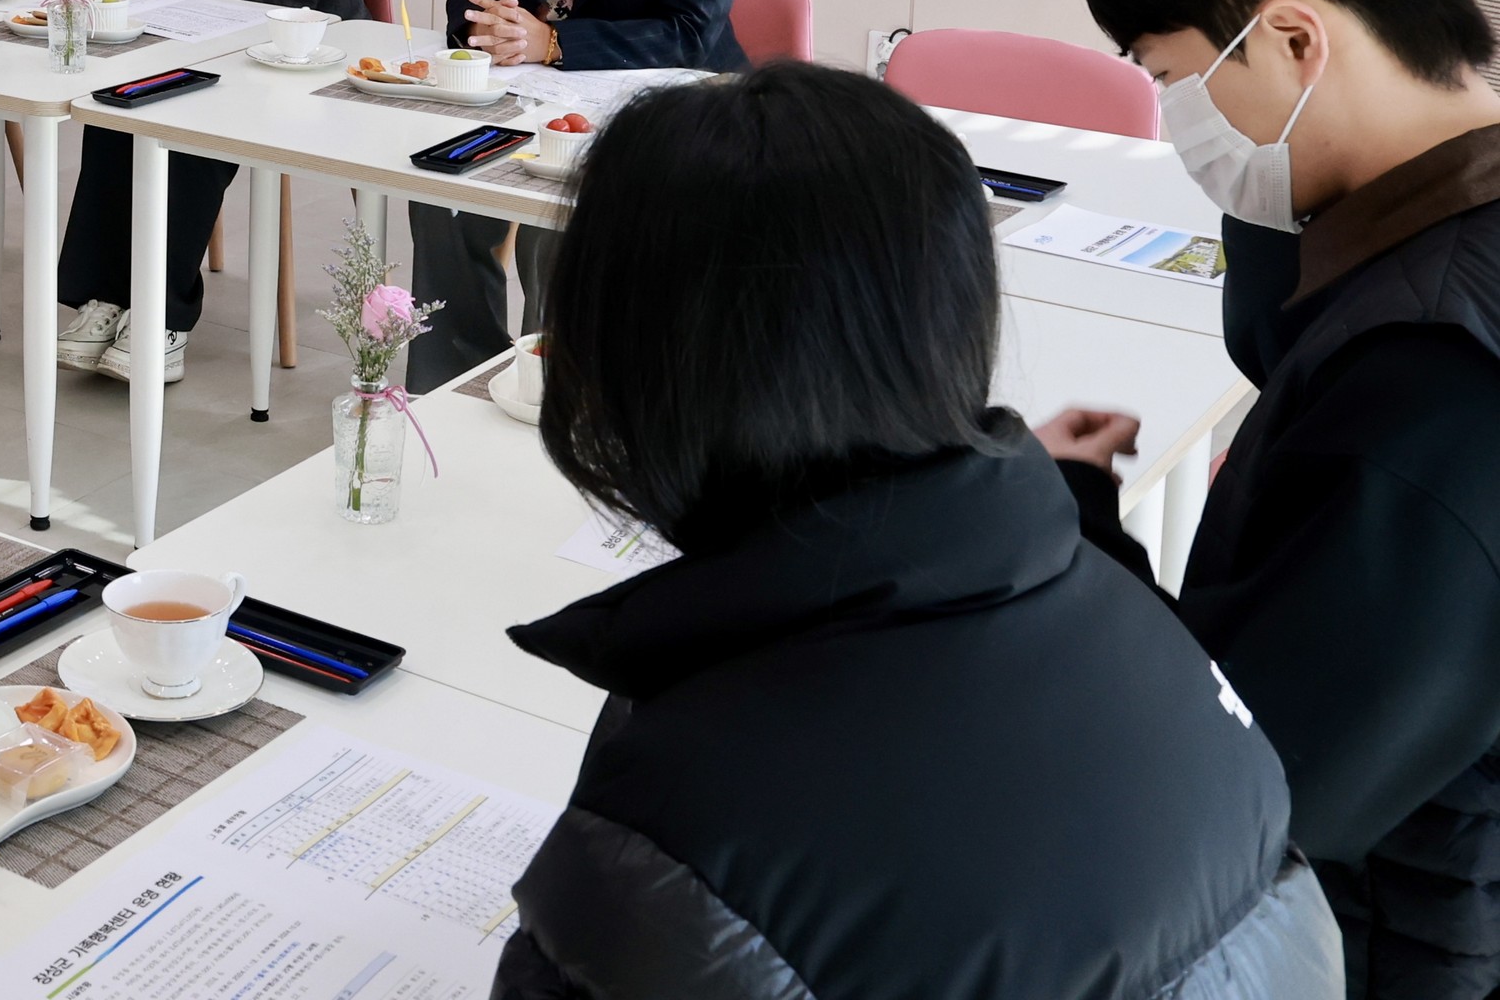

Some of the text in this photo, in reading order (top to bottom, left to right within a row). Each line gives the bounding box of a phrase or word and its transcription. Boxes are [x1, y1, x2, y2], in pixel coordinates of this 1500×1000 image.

[32, 871, 183, 985] 장성군 가족행복센터 운영 현황
